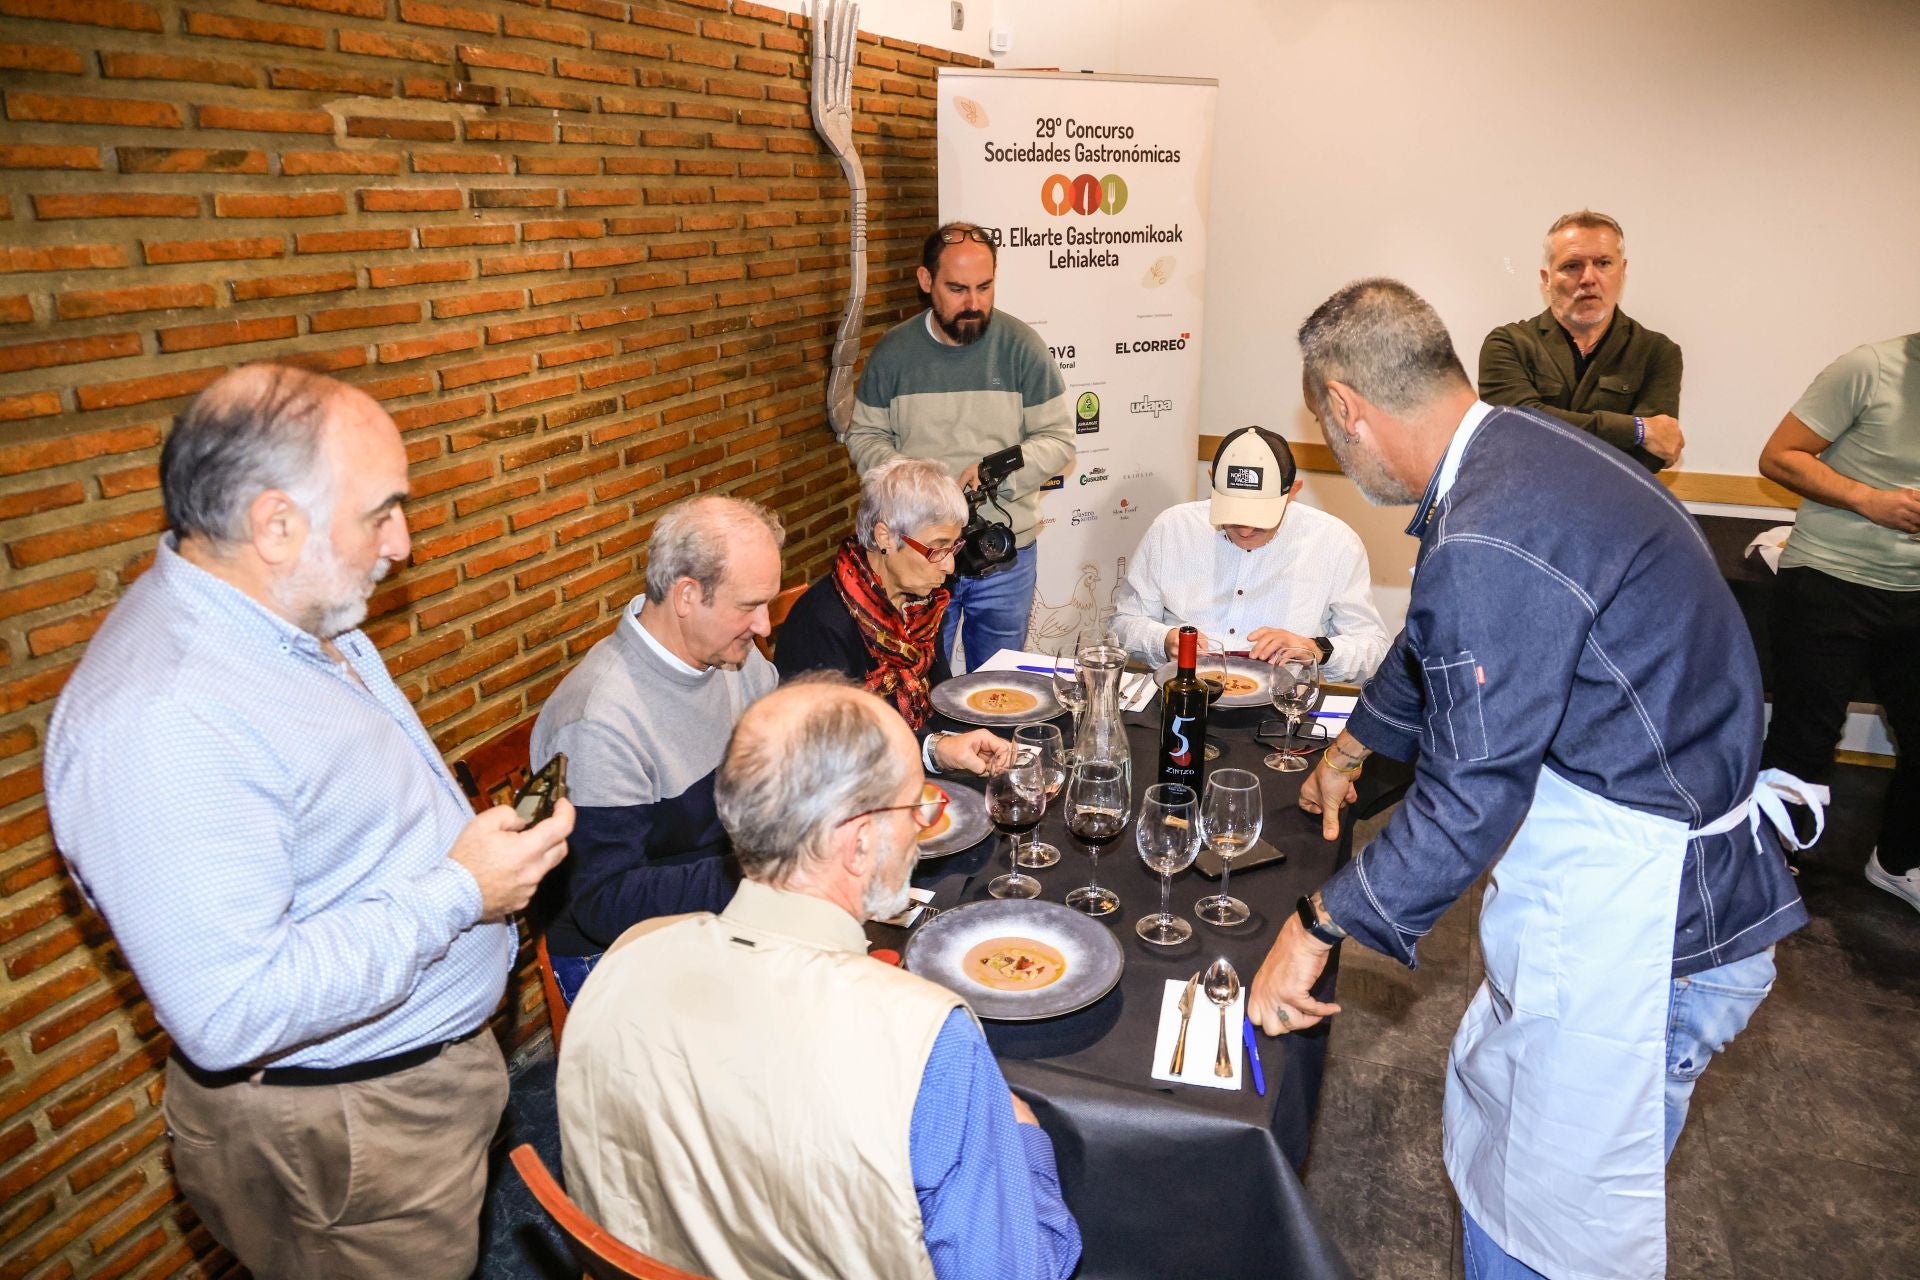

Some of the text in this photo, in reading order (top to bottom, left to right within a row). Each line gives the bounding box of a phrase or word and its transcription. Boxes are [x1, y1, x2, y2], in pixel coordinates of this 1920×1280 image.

[1036, 117, 1134, 139] 29º Concurso
[984, 142, 1181, 163] Sociedades Gastronómicas
[993, 224, 1183, 247] 9. Elkarte Gastronomikoak
[1049, 249, 1119, 269] Lehiaketa
[1048, 345, 1076, 359] ava
[1116, 339, 1186, 354] EL CORREO
[1059, 361, 1076, 370] foral
[1130, 395, 1172, 418] udapa
